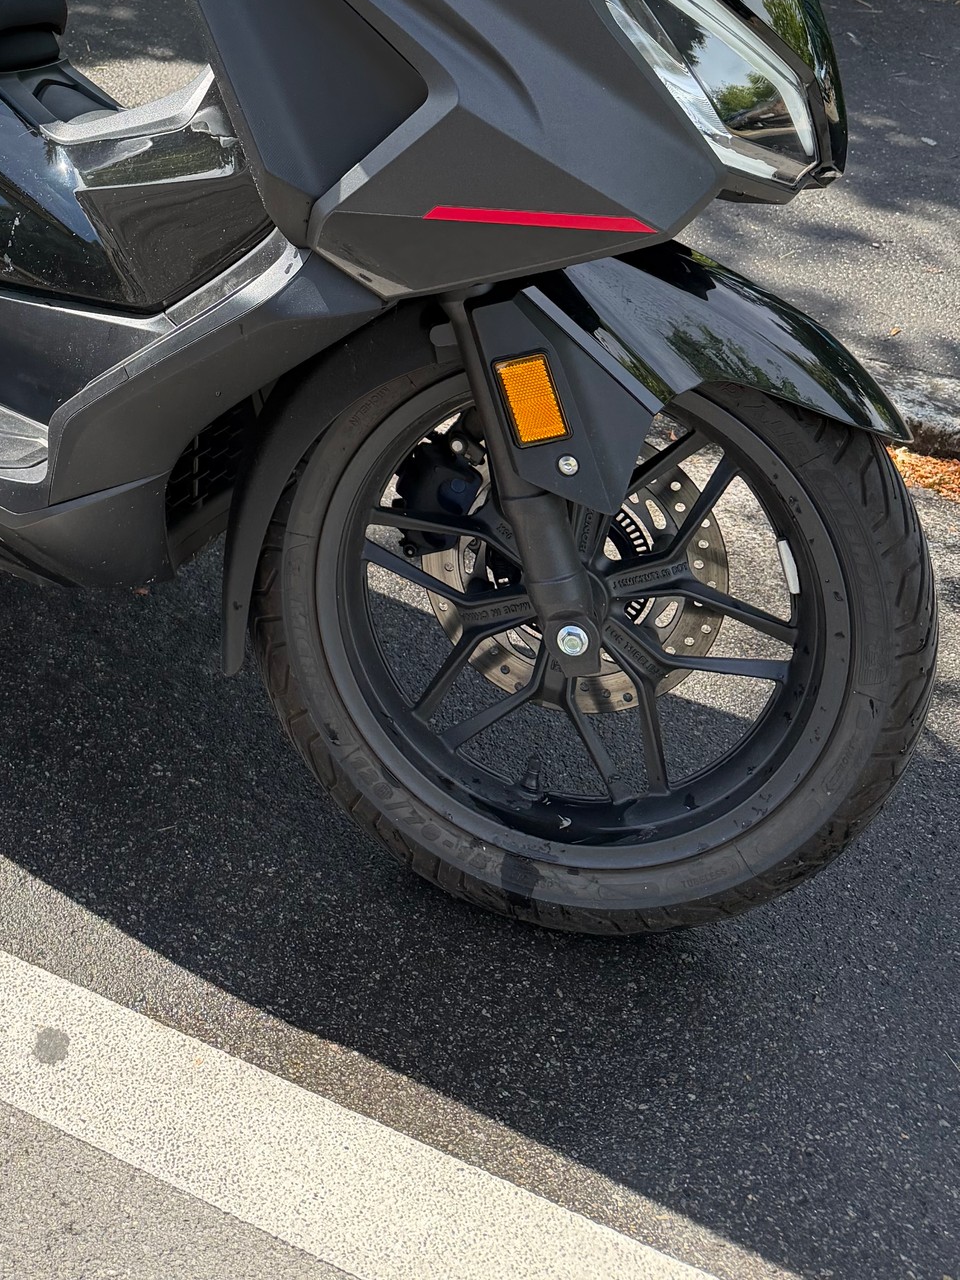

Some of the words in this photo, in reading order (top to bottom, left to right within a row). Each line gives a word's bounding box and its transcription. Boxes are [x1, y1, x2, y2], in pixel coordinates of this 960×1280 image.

[348, 385, 391, 427] MICHELIN
[503, 601, 531, 614] MADE
[681, 866, 729, 890] TUBELESS
